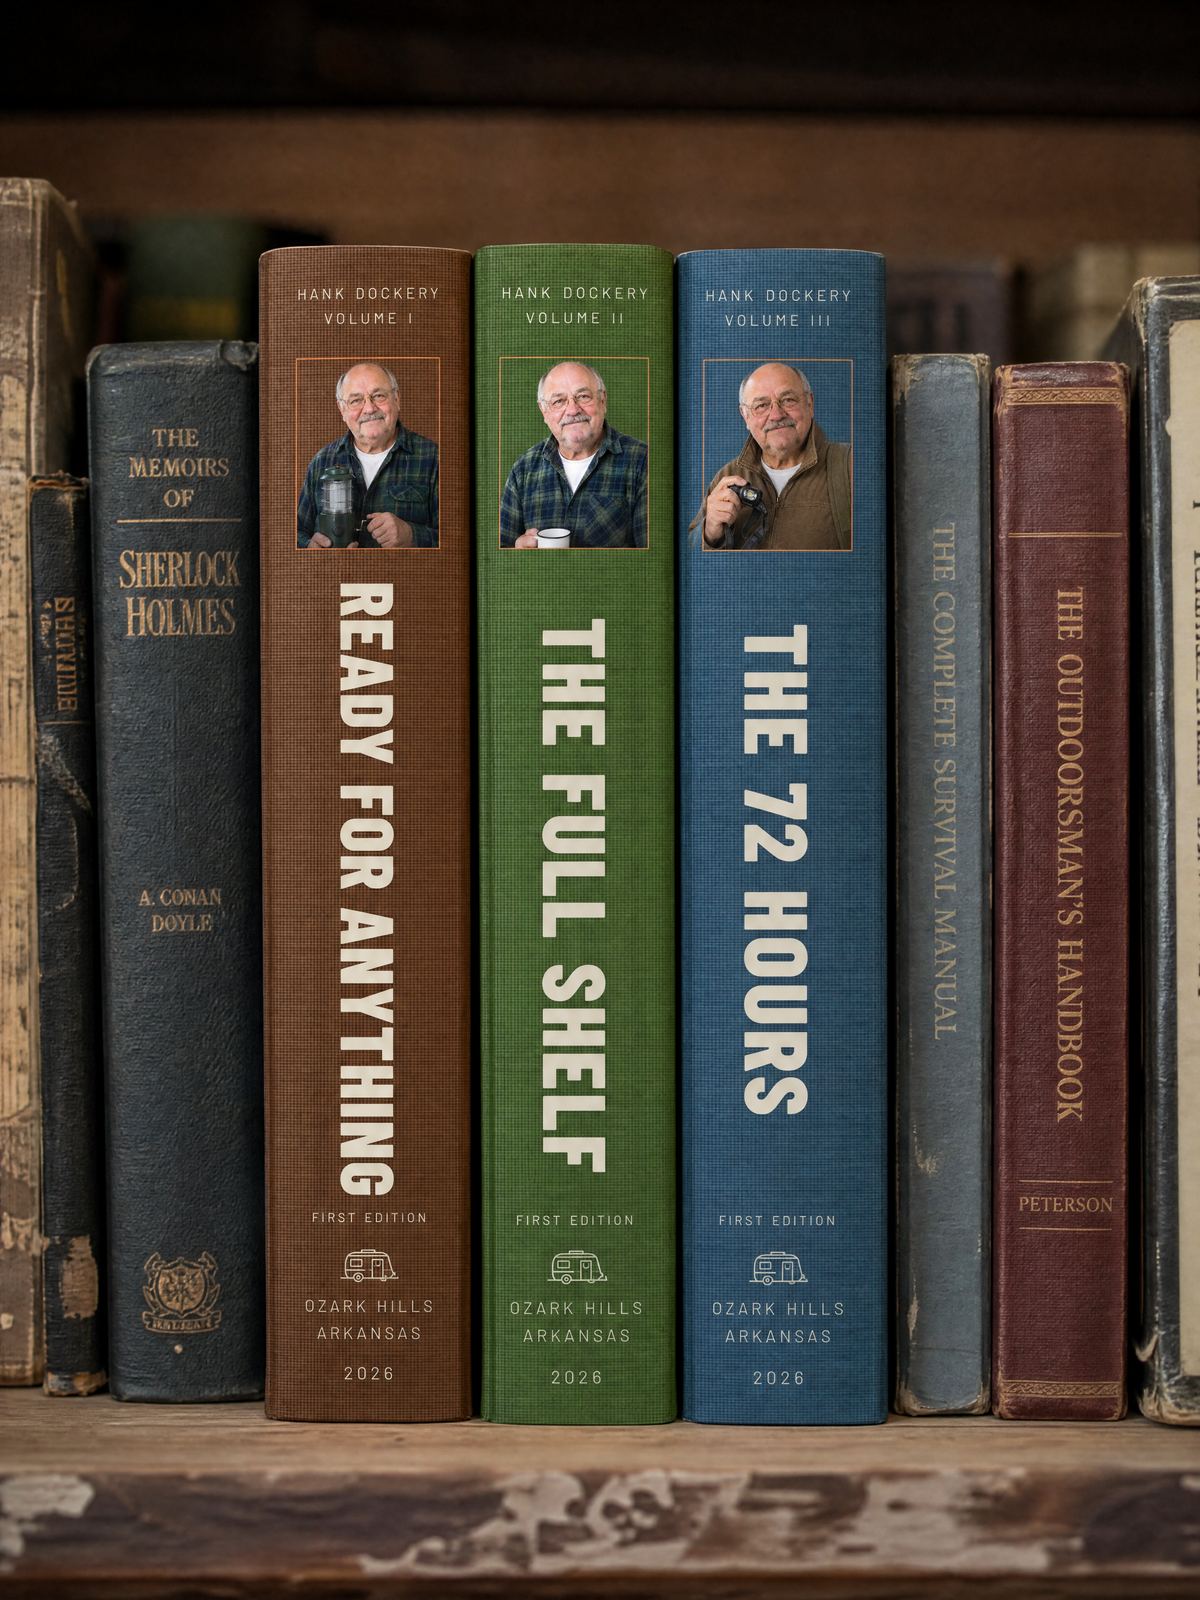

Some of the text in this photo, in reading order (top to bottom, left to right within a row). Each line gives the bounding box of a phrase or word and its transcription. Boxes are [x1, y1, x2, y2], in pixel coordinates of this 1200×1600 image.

[297, 287, 439, 301] HANK DOCKERY
[502, 286, 648, 300] HANK DOCKERY
[705, 288, 852, 302] HANK DOCKERY
[324, 312, 398, 325] VOLUME
[525, 312, 624, 325] VOLUME II
[724, 314, 831, 327] VOLUME III
[152, 428, 199, 448] THE
[128, 456, 230, 478] MEMOIRS
[163, 488, 195, 509] OF
[118, 549, 240, 590] SHERLOCK
[125, 596, 237, 638] HOLMES
[932, 521, 957, 1040] THE COMPLETE SURVIVAL MANUAL
[1056, 587, 1083, 1123] THE OUTDOORSMAN'S HANDBOOK
[743, 624, 808, 1115] THE 72 HOURS
[339, 582, 394, 1196] READY FOR ANYTHING
[542, 618, 606, 1173] THE FULL SHELF
[138, 888, 222, 906] A. CONAN
[151, 914, 212, 933] DOYLE
[1018, 1195, 1113, 1213] PETERSON
[311, 1212, 427, 1224] FIRST EDITION
[516, 1214, 635, 1226] FIRST EDITION
[718, 1214, 836, 1226] FIRST EDITION
[304, 1299, 433, 1314] OZARK HILLS
[510, 1301, 643, 1316] OZARK HILLS
[712, 1301, 845, 1316] OZARK HILLS
[316, 1327, 422, 1341] ARKANSAS
[523, 1329, 631, 1343] ARKANSAS
[724, 1329, 832, 1344] ARKANSAS
[343, 1366, 395, 1381] 2026
[551, 1370, 603, 1385] 2026
[753, 1371, 804, 1385] 2026
